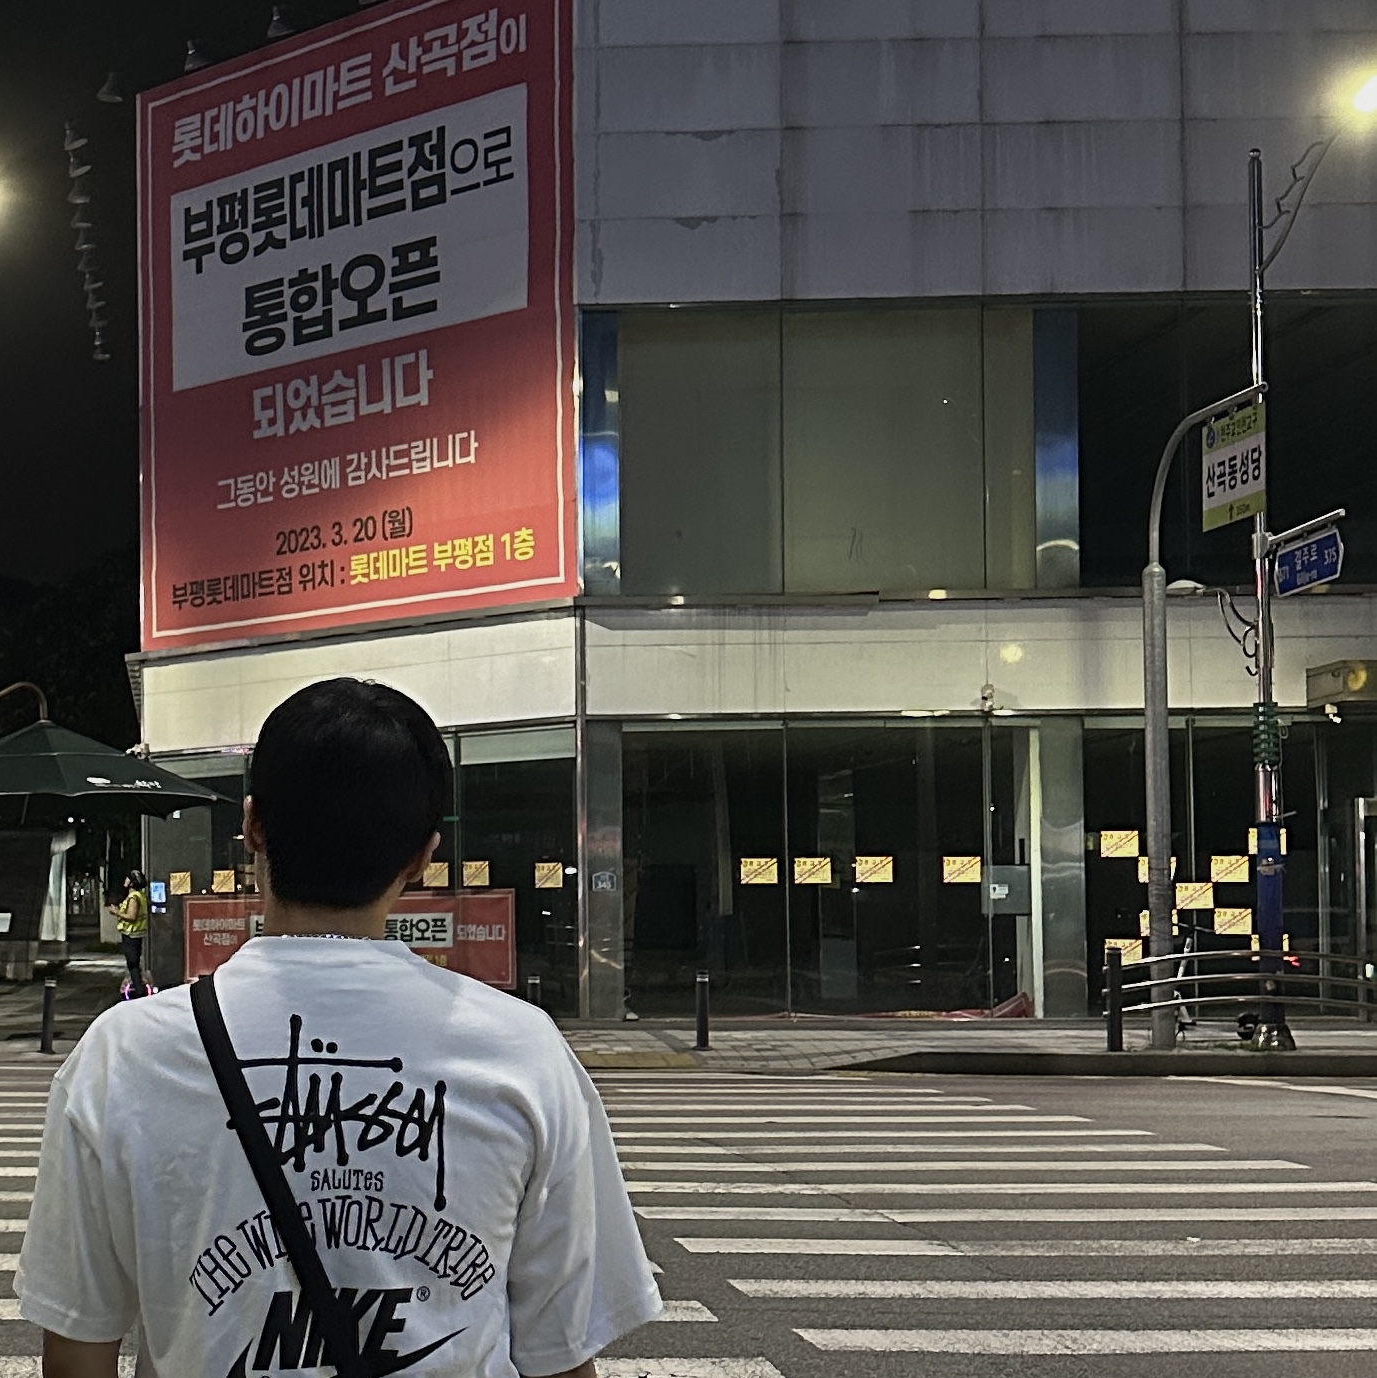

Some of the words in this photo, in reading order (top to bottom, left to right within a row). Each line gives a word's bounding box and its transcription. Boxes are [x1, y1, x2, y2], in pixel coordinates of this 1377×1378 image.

[172, 53, 373, 168] 롯데하이마트
[381, 8, 528, 96] 산곡점이
[182, 125, 515, 275] 부평롯데마트점으로
[242, 235, 441, 357] 통합오픈
[252, 349, 434, 440] 되었습니다
[217, 472, 276, 510] 그동안
[281, 457, 341, 501] 성원에
[346, 430, 479, 486] 감사드립니다
[1205, 444, 1262, 499] 산곡동성당
[171, 565, 293, 611] 부평롯데마트점
[349, 544, 427, 587] 롯데마트
[432, 535, 495, 573] 부평점
[500, 527, 536, 561] 1층
[275, 527, 327, 556] 2023.
[383, 918, 448, 942] 통합오픈
[456, 924, 507, 942] 되었습니다
[317, 1195, 429, 1262] WORLD
